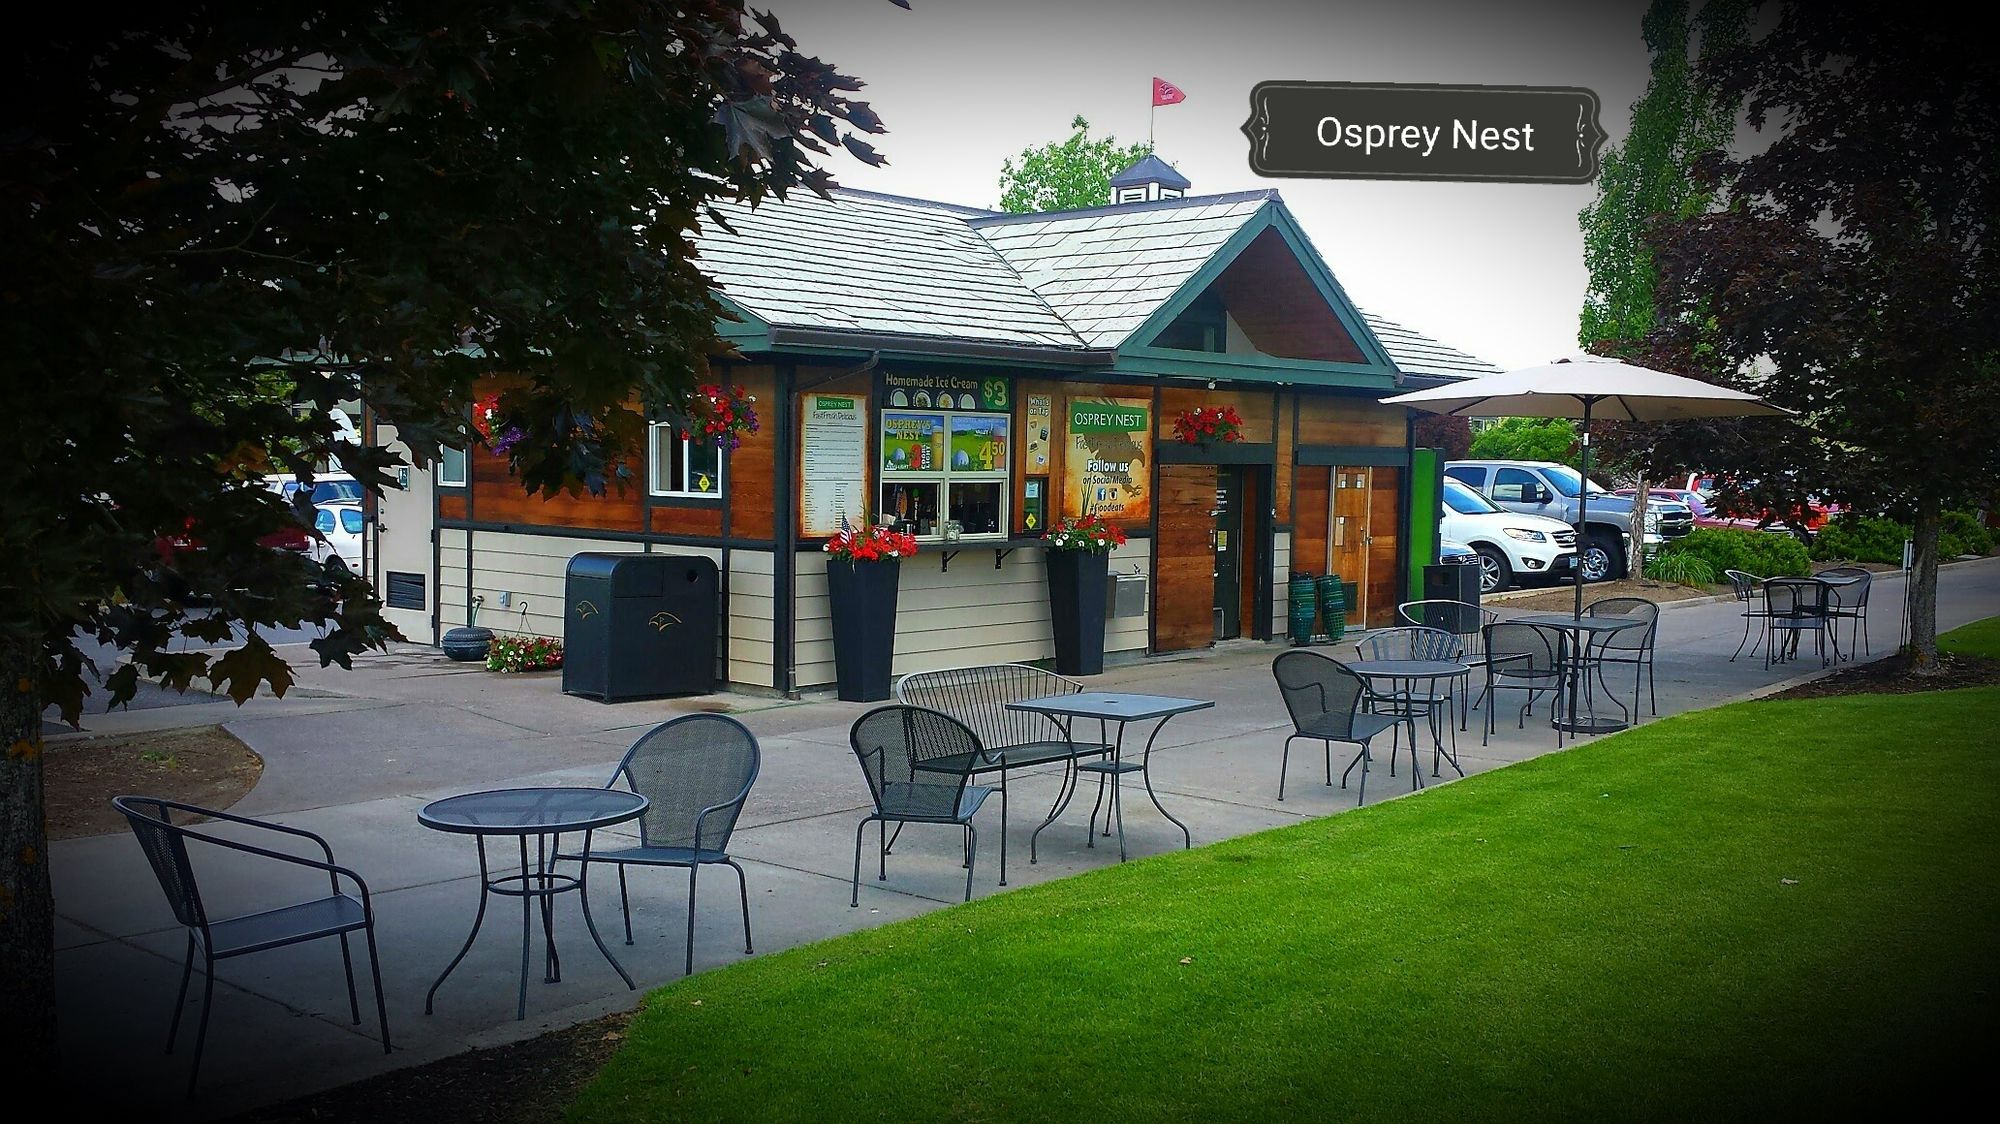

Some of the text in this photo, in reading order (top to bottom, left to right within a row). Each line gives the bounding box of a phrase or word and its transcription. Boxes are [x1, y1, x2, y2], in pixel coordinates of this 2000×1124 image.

[885, 373, 978, 389] Homemade Ice Cream
[984, 379, 1007, 406] $3
[1074, 412, 1142, 427] OSPREY NEST
[896, 429, 921, 441] NEST
[1087, 459, 1129, 472] Follow us
[1082, 475, 1132, 485] on Social Media
